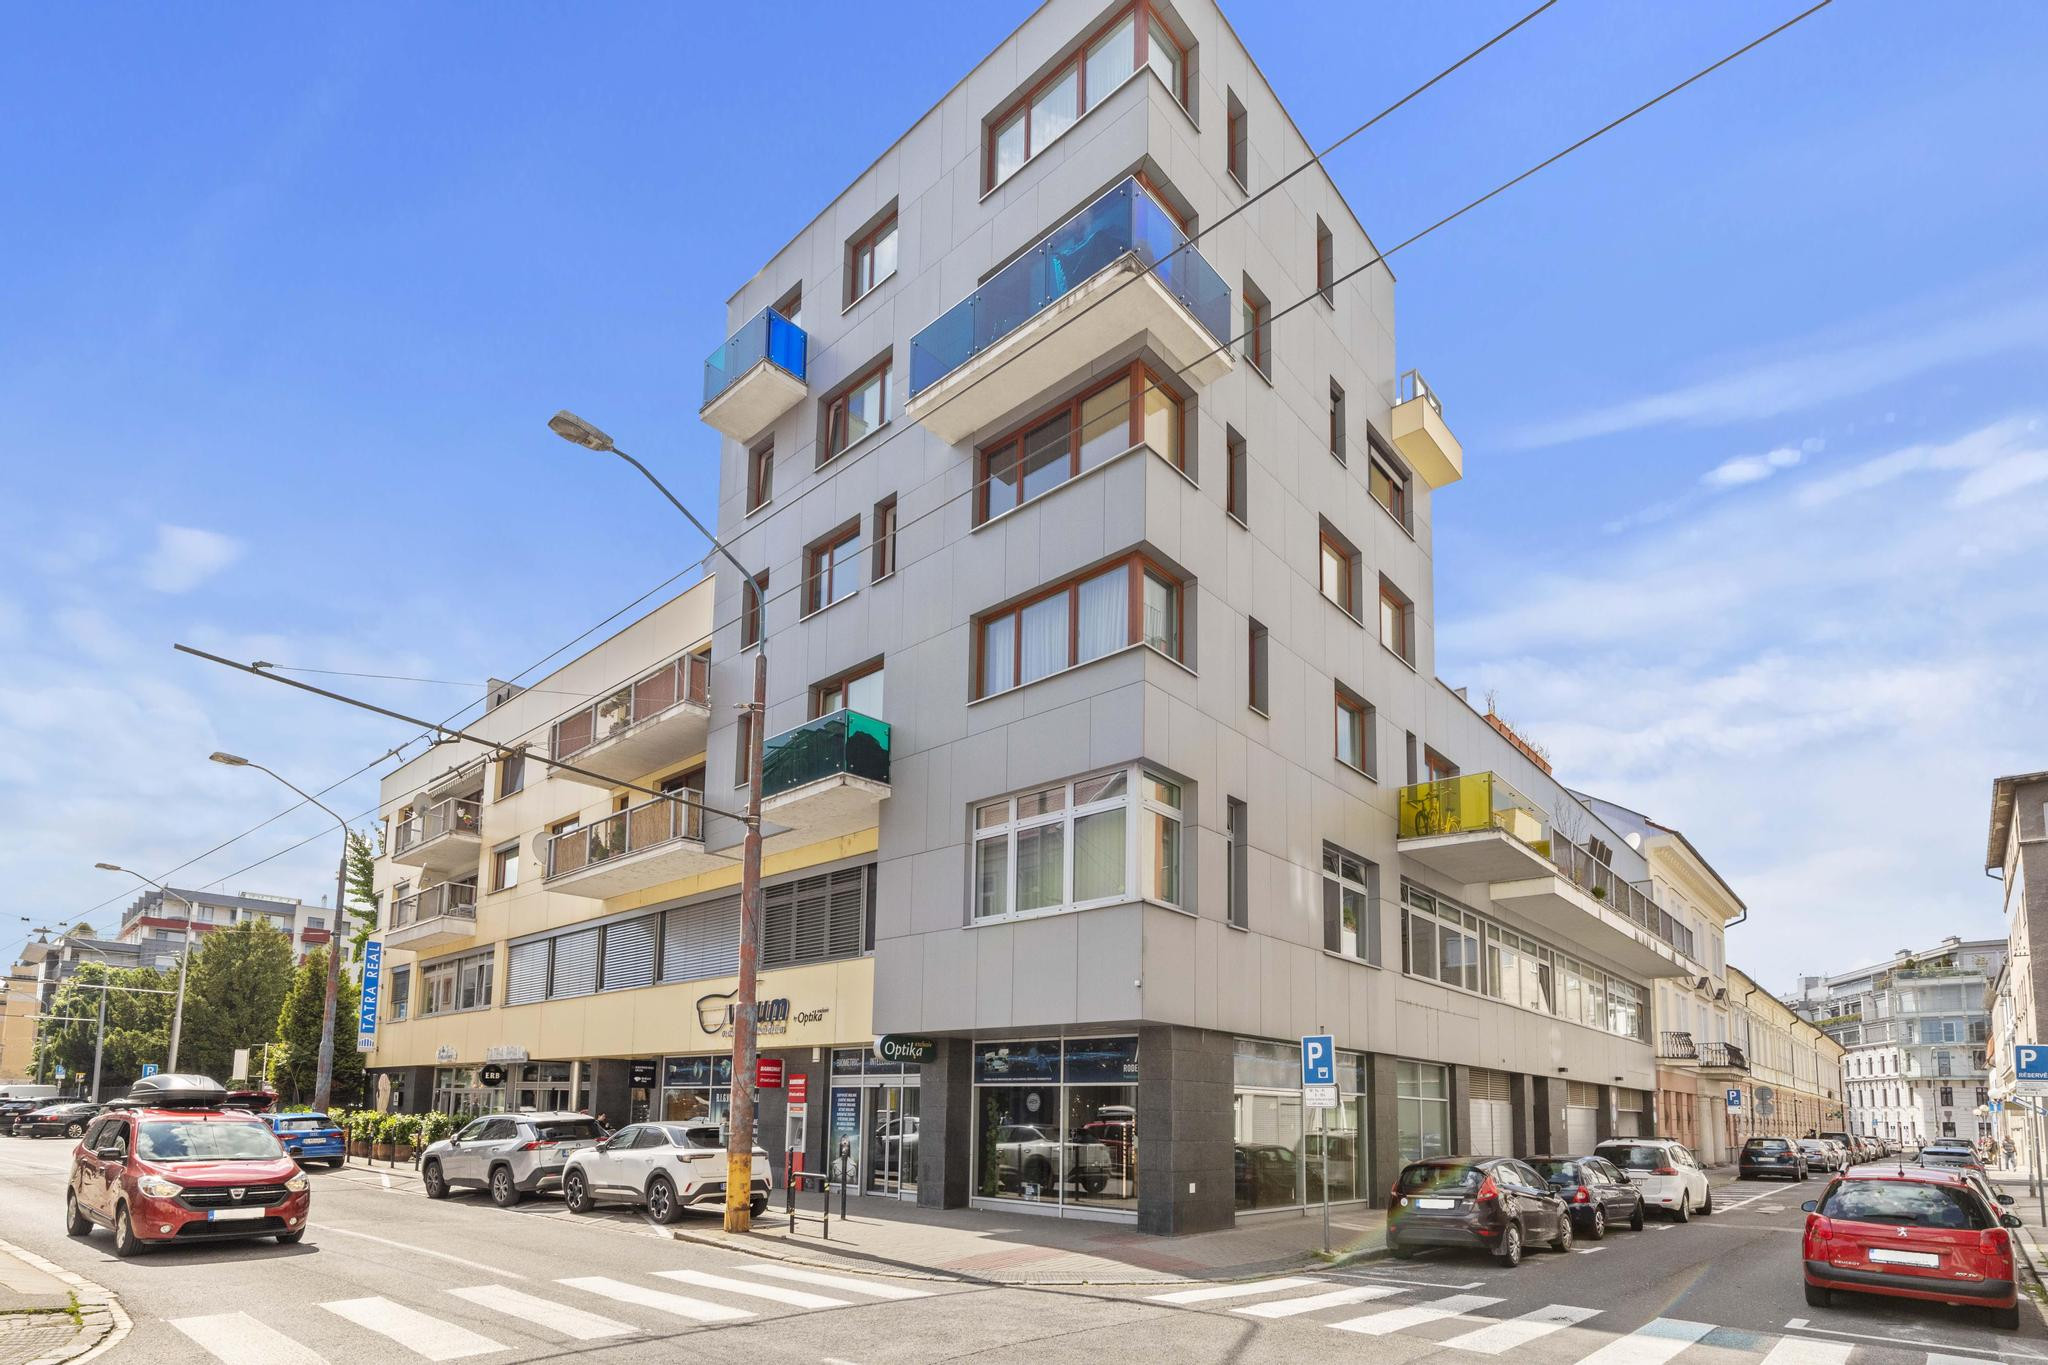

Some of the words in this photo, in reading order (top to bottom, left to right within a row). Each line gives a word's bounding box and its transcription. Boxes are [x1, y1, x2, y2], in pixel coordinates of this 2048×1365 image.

[366, 946, 380, 978] REAL
[362, 986, 376, 1030] TATRA
[797, 1010, 823, 1026] Optika
[884, 1041, 923, 1060] Optika
[1307, 1042, 1323, 1070] P
[2020, 1049, 2037, 1070] P
[146, 1066, 155, 1076] P
[1730, 1090, 1737, 1101] P
